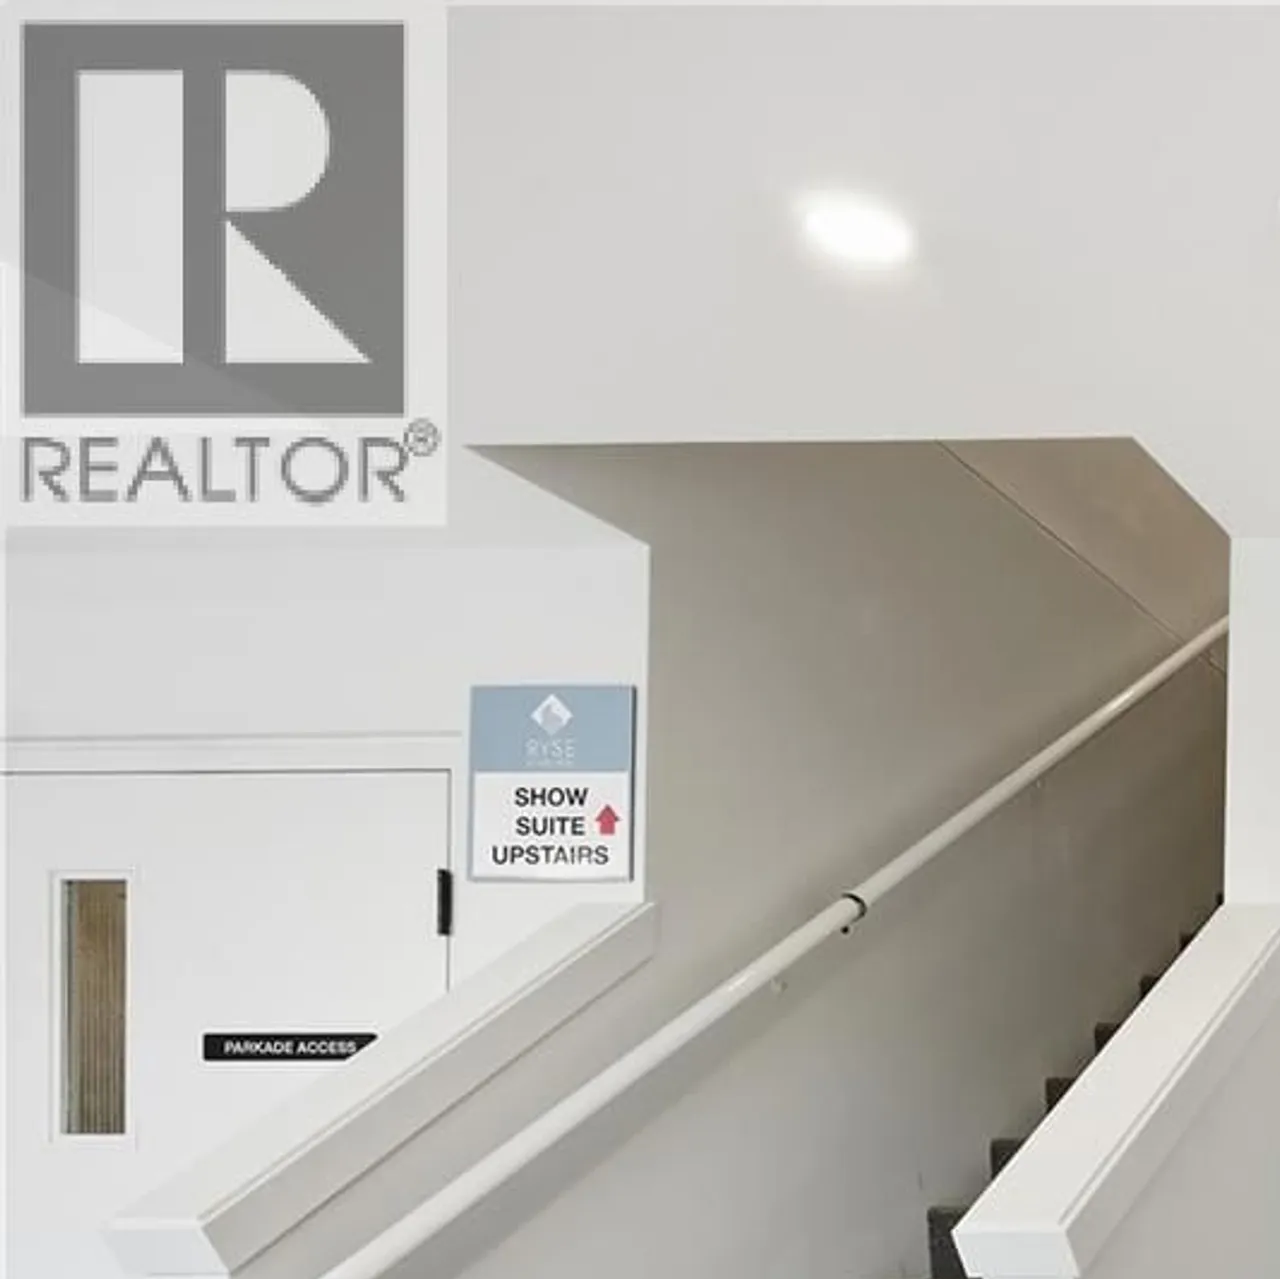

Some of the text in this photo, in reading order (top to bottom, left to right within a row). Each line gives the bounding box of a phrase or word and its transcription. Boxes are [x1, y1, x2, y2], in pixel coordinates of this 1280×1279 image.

[525, 738, 575, 759] RYSE
[514, 787, 589, 807] SHOW
[515, 816, 586, 836] SUITE
[491, 845, 610, 865] UPSTAIRS
[223, 1041, 357, 1055] PARKADE ACCESS
